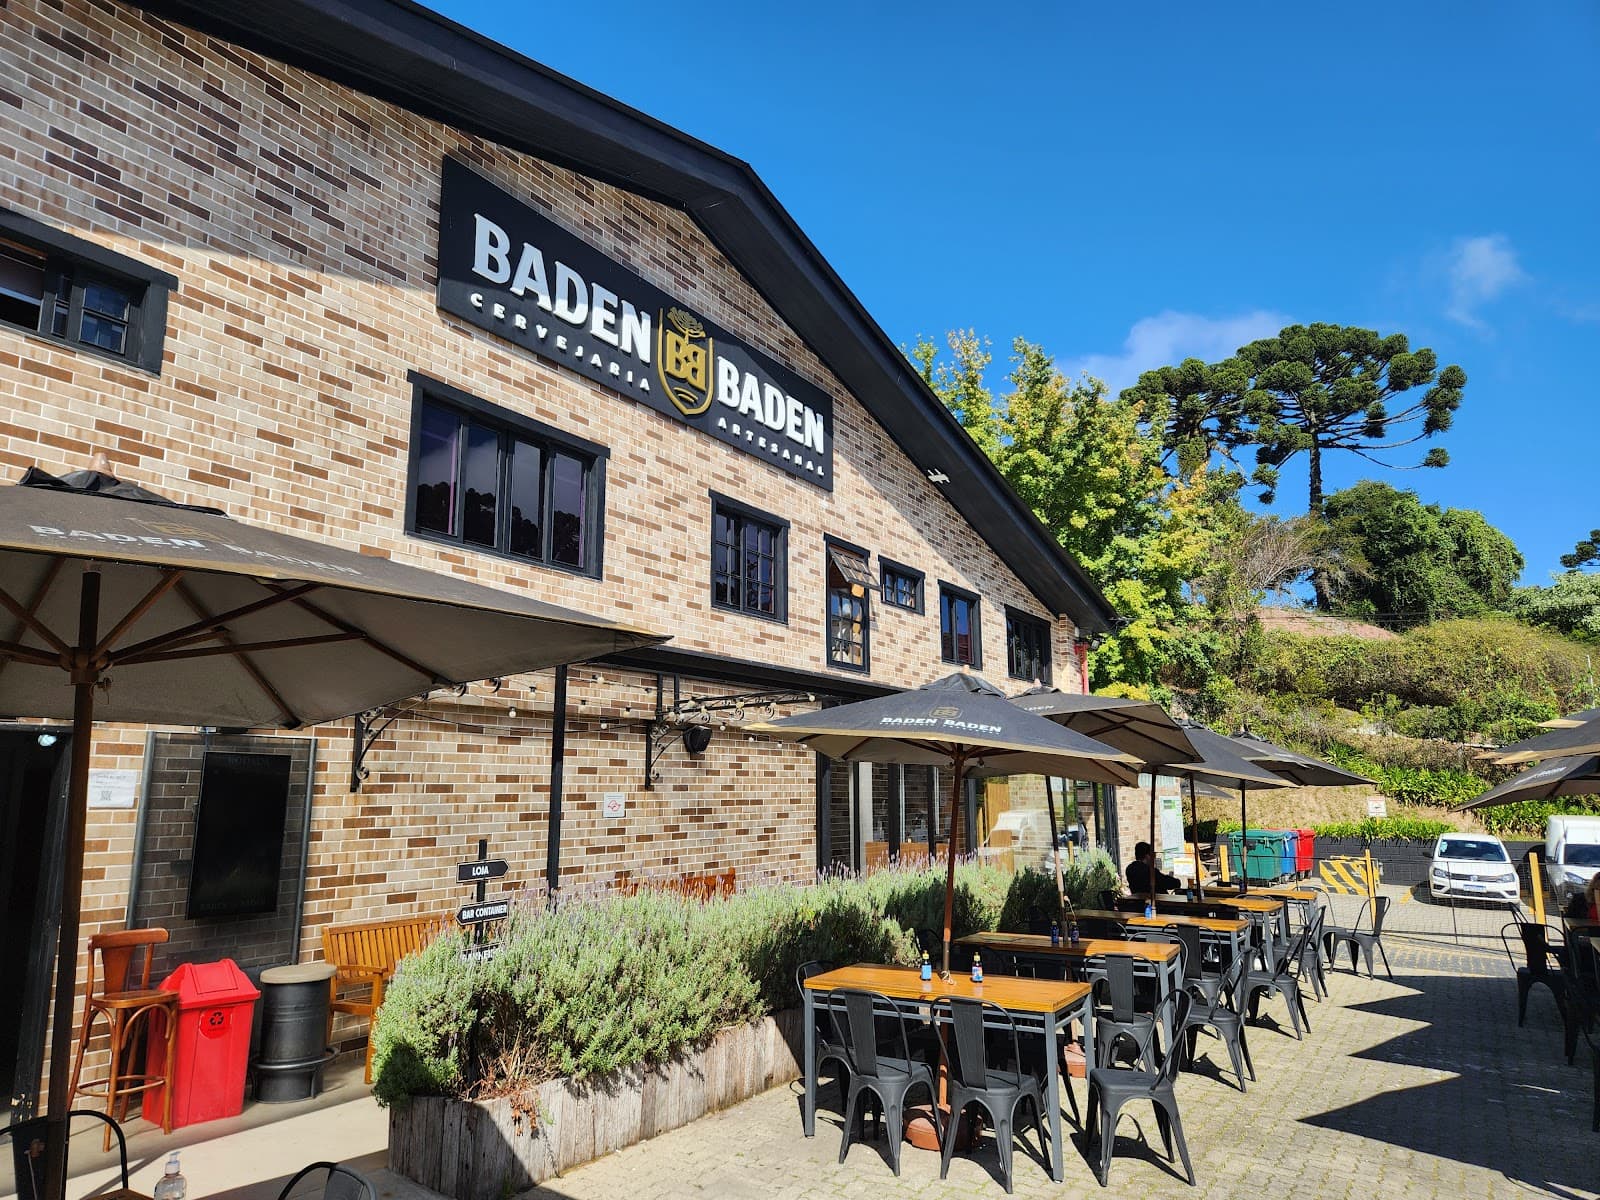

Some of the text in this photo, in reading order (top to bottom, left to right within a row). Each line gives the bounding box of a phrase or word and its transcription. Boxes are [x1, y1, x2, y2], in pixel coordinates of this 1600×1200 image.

[471, 212, 824, 455] BADEN BADEN
[470, 293, 825, 477] CERVEJARIA ARTESANAL
[29, 525, 207, 549] BADEN
[881, 716, 937, 725] BADEN
[943, 719, 1002, 733] BADEN
[472, 865, 489, 876] LOJA
[462, 904, 507, 920] BAR CONTAINER
